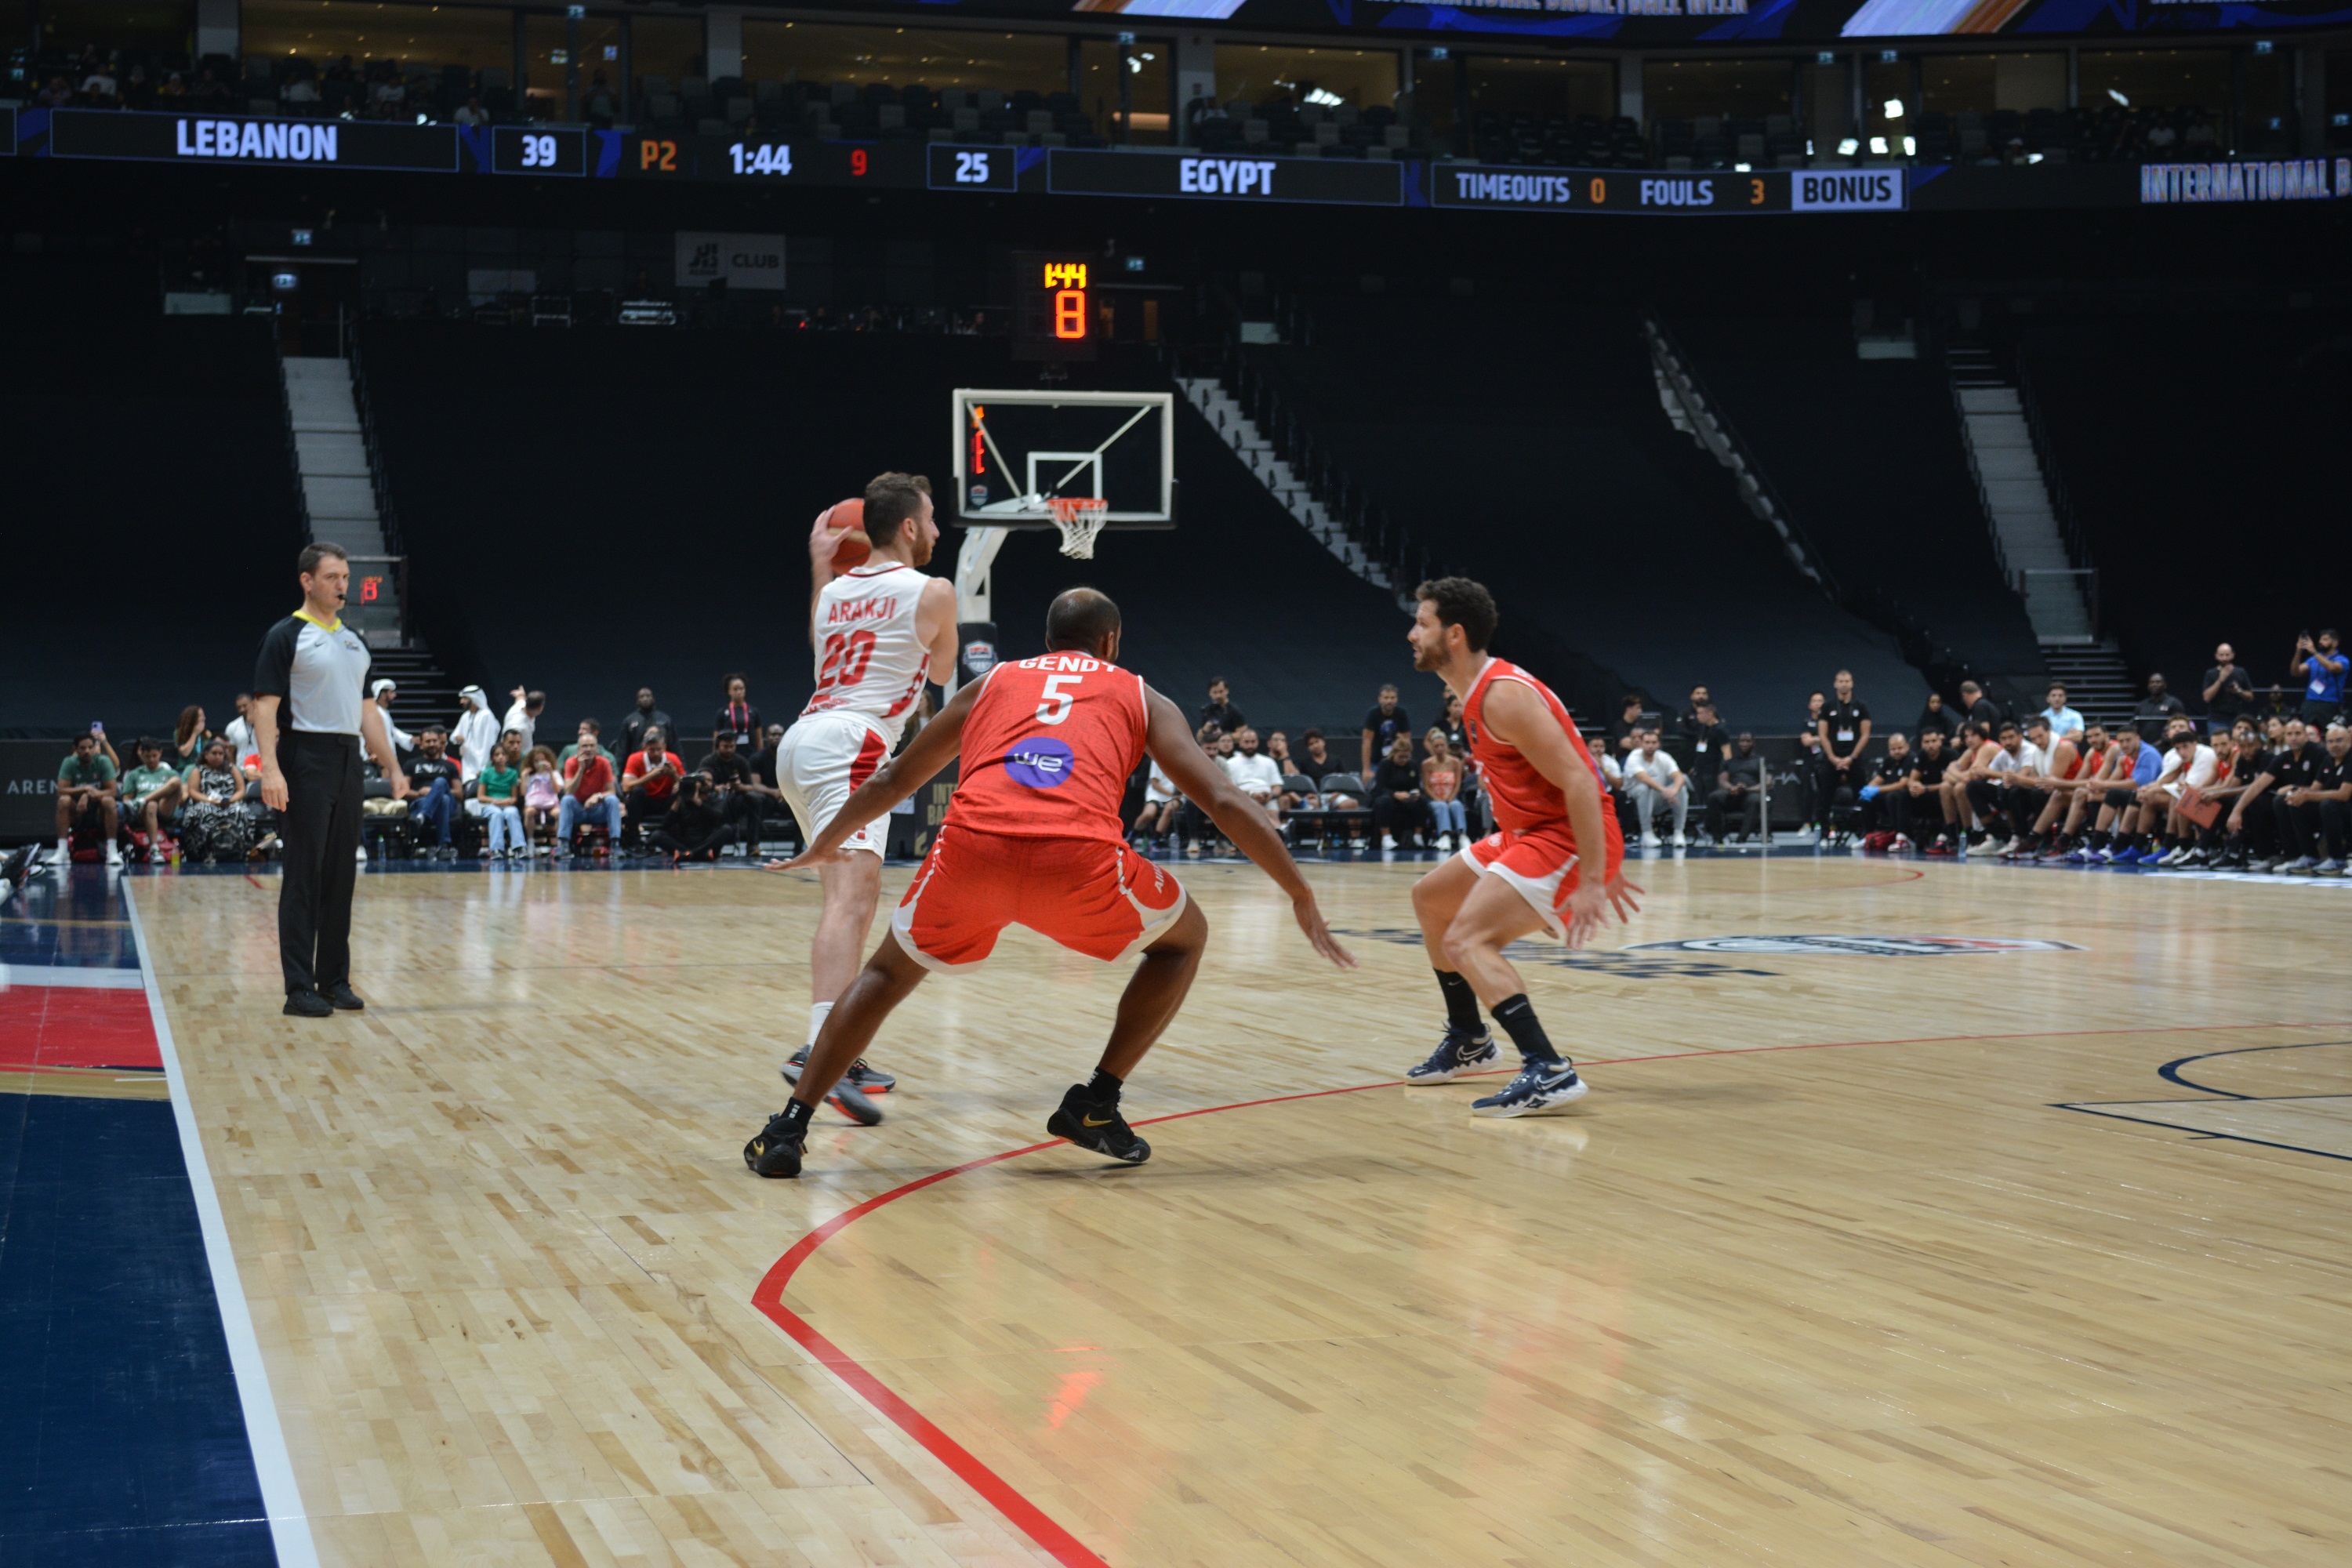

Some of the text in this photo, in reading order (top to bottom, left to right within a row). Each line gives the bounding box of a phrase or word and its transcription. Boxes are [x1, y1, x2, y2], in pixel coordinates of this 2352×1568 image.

[176, 118, 338, 162] LEBANON
[521, 136, 557, 167] 39
[641, 140, 677, 171] P2
[729, 143, 793, 176] 1:44
[851, 149, 867, 176] 9
[956, 151, 989, 183] 25
[1180, 158, 1276, 195] EGYPT
[1456, 172, 1606, 204] TIMEOUTS 0
[1803, 176, 1892, 203] BONUS
[2140, 158, 2330, 203] INTERNATIONAL
[1640, 179, 1765, 206] FOULS 3
[731, 253, 779, 269] CLUB
[1055, 290, 1086, 339] 8
[828, 597, 898, 624] ARAKJI
[818, 630, 877, 690] 20
[1018, 656, 1119, 673] GENDY
[1036, 674, 1083, 725] 5
[7, 779, 58, 794] AREN
